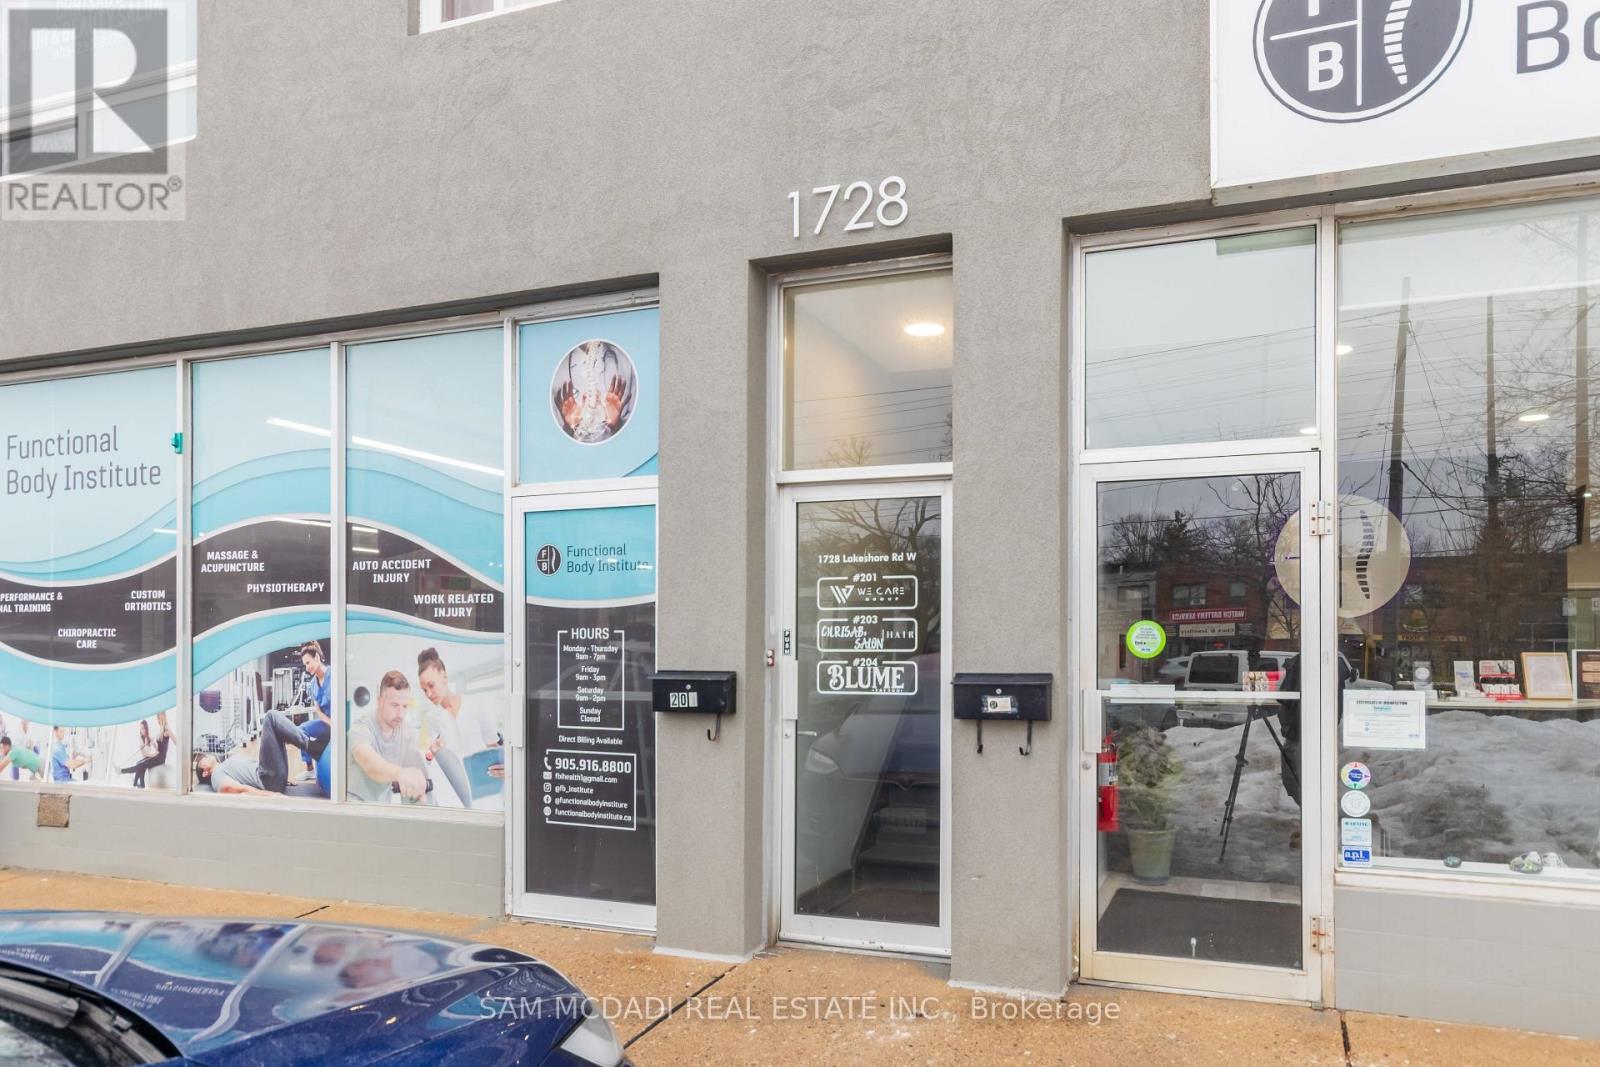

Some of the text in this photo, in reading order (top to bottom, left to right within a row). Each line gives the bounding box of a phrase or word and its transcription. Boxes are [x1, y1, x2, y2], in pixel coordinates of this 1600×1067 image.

[787, 175, 908, 238] 1728
[7, 425, 118, 460] Functional
[7, 463, 161, 499] Body Institute
[207, 550, 259, 561] MASSAGE &
[567, 543, 626, 557] Functional
[818, 551, 917, 564] 1728 Lakeshore Rd W
[201, 562, 265, 573] ACUPUNCTURE
[352, 559, 431, 571] AUTO ACCIDENT
[567, 560, 595, 576] Body
[373, 572, 410, 584] INJURY
[852, 573, 877, 583] #201
[247, 582, 325, 593] PHYSIOTHERAPY
[857, 586, 872, 596] WE
[876, 586, 905, 596] CARE
[0, 591, 63, 602] PERFORMANCE &
[131, 590, 166, 600] CUSTOM
[414, 593, 494, 605] WORK RELATED
[14, 604, 52, 613] TRAINING
[124, 601, 172, 612] ORTHOTICS
[434, 606, 473, 618] INJURY
[852, 615, 879, 625] #203
[57, 628, 117, 638] CHIROPRACTIC
[571, 628, 610, 640] HOURS
[886, 630, 915, 639] HAIR
[76, 639, 98, 650] CARE
[563, 644, 587, 654] Monday
[590, 644, 619, 654] Thursday
[575, 653, 589, 661] 9am
[593, 653, 606, 662] 7pm
[852, 657, 878, 667] #204
[581, 665, 600, 675] Friday
[827, 665, 905, 690] BLUME
[577, 686, 605, 695] Saturday
[575, 694, 589, 702] 9am
[579, 706, 602, 715] Sunday
[580, 715, 601, 723] Closed
[558, 734, 576, 743] Direct
[596, 736, 623, 745] Available
[555, 757, 632, 774] 905.916.8800
